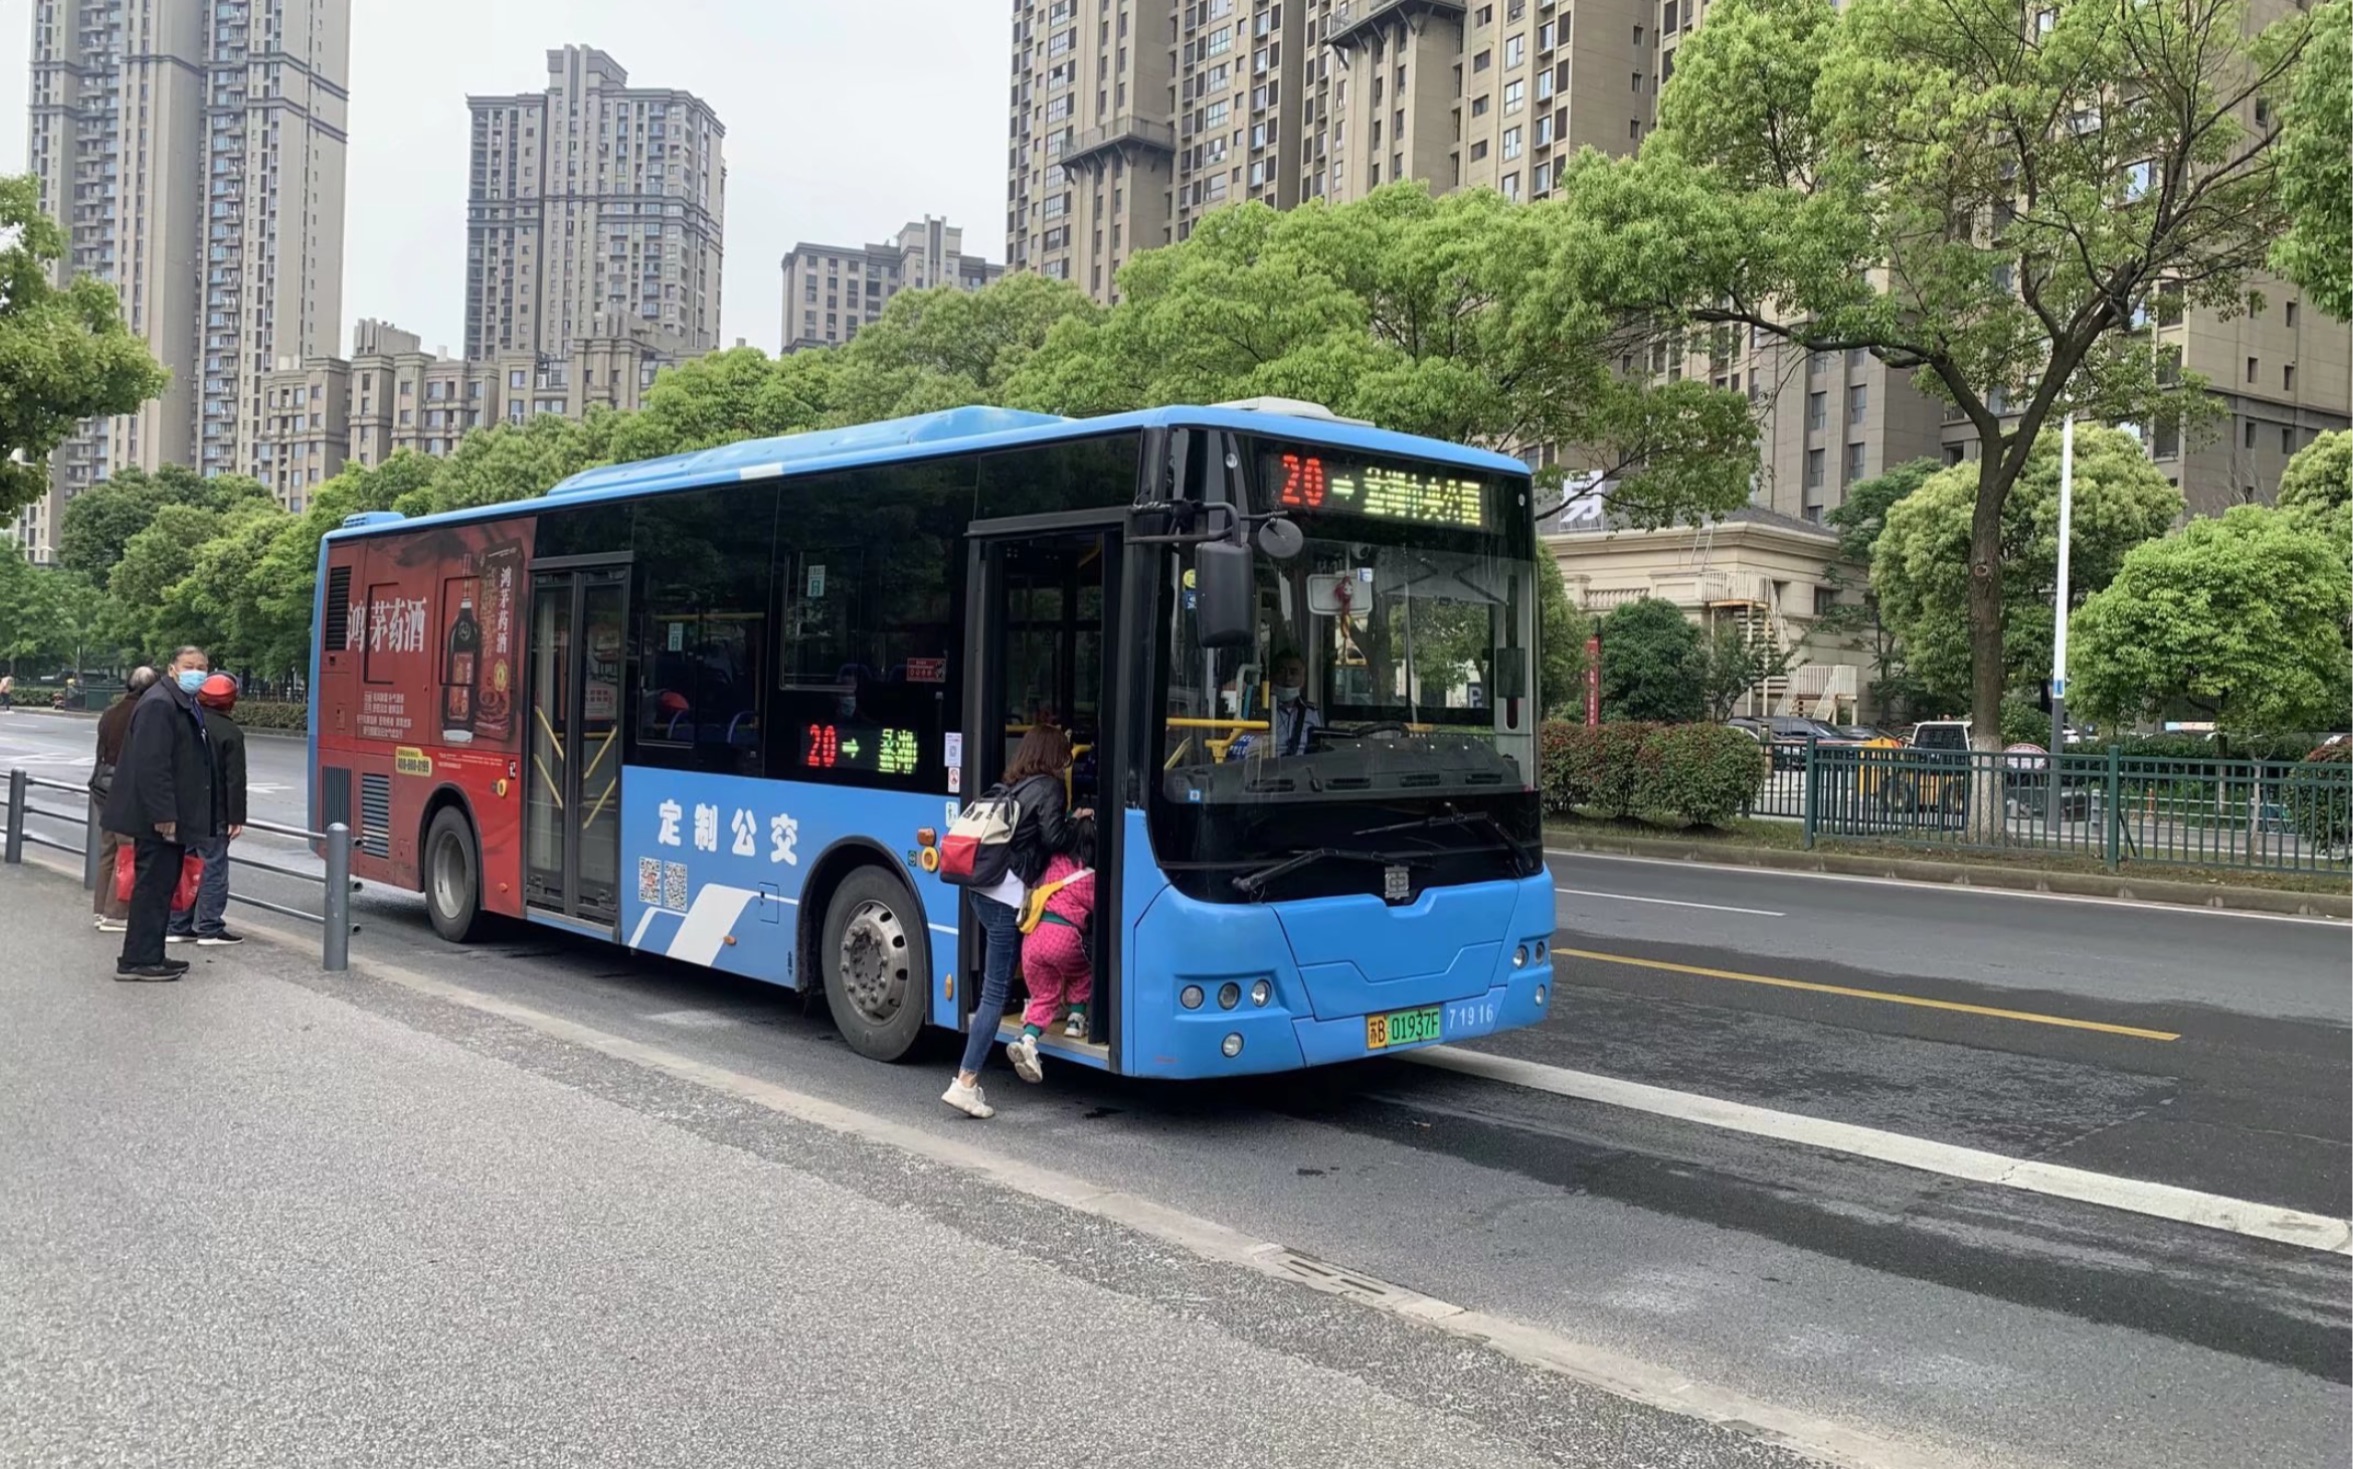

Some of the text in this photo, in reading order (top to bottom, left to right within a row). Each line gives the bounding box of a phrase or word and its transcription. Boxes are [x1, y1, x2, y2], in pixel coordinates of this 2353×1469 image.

[1281, 453, 1324, 507] 20
[345, 596, 428, 654] 鸿茅药酒
[495, 565, 512, 655] 鸿茅药酒
[808, 723, 836, 768] 20
[657, 798, 799, 867] 定制公交
[1448, 1003, 1494, 1030] 71916
